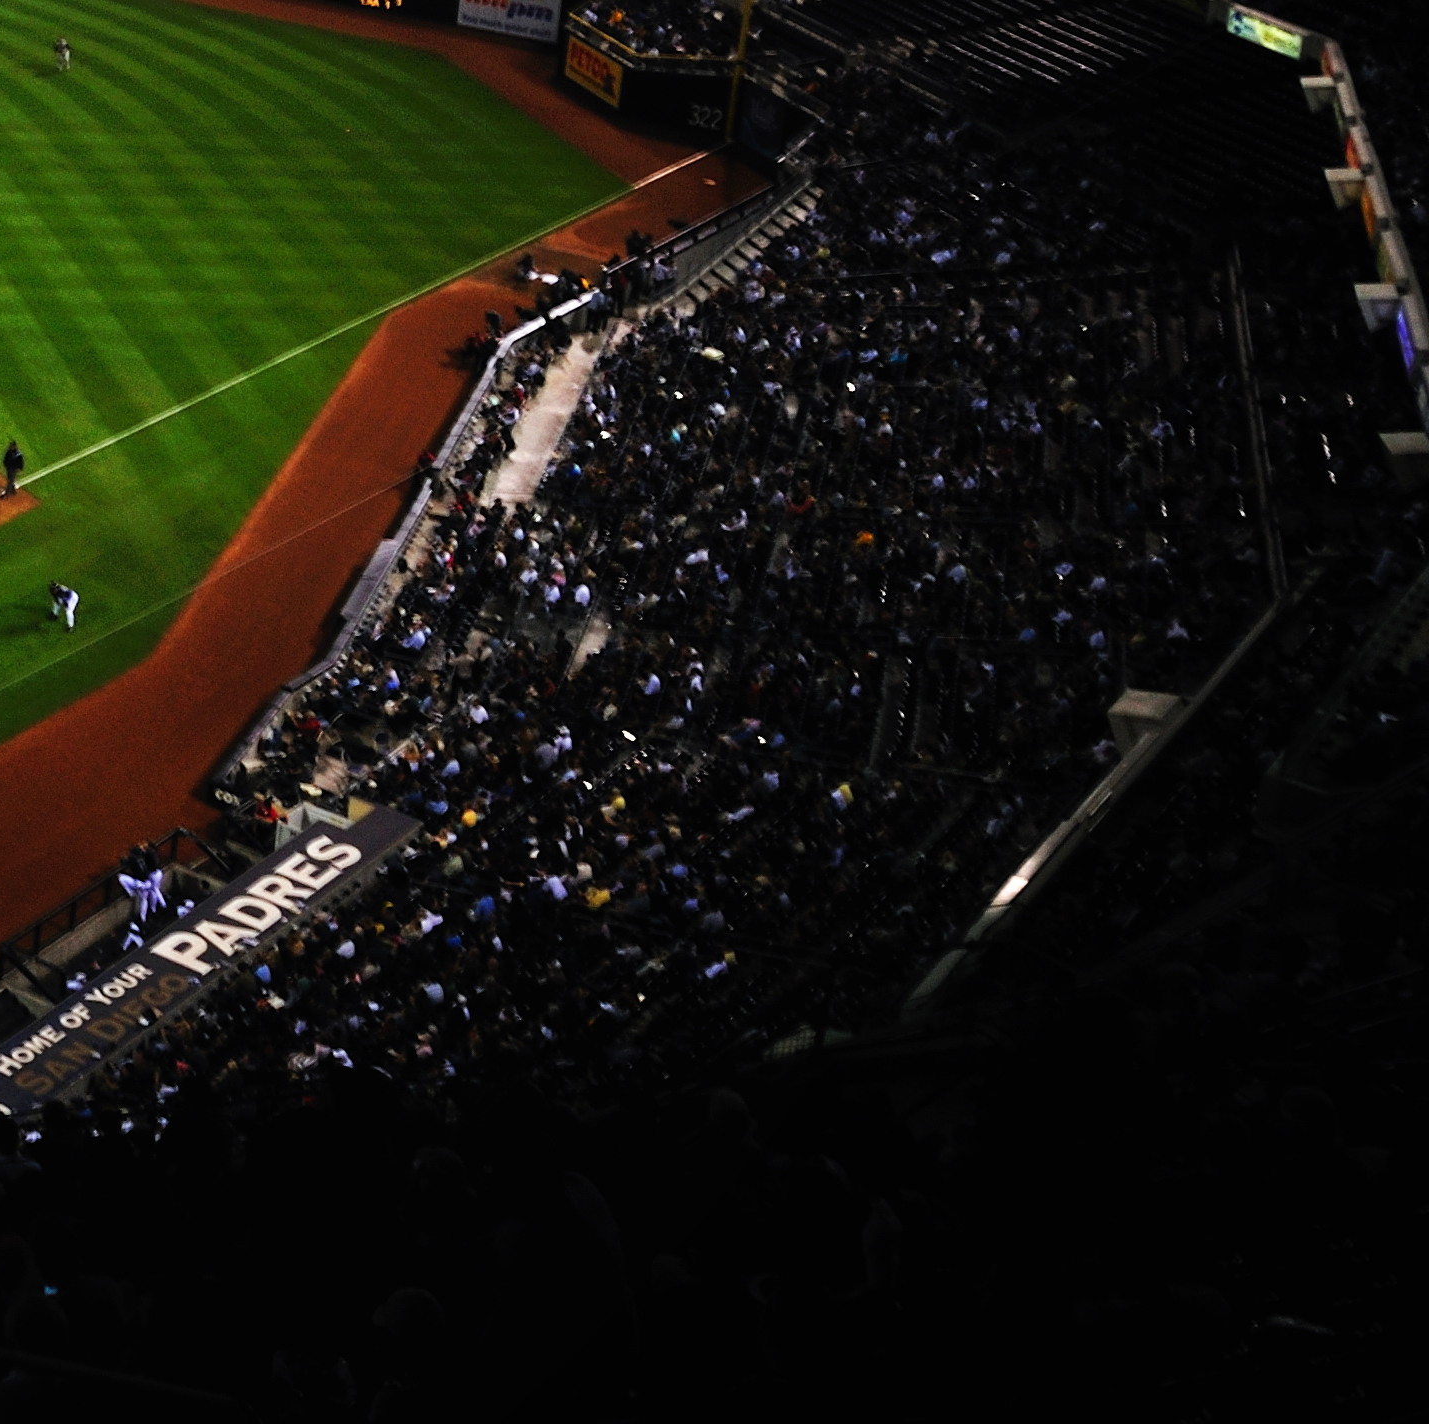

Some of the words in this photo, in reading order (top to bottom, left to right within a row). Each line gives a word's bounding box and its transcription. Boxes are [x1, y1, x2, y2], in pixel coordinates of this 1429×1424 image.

[690, 104, 722, 128] 322
[151, 834, 362, 977] PADRES
[14, 1042, 97, 1095] SAN
[88, 972, 189, 1044] DIEGO
[59, 1002, 91, 1031] OF
[84, 962, 153, 1006] YOUR
